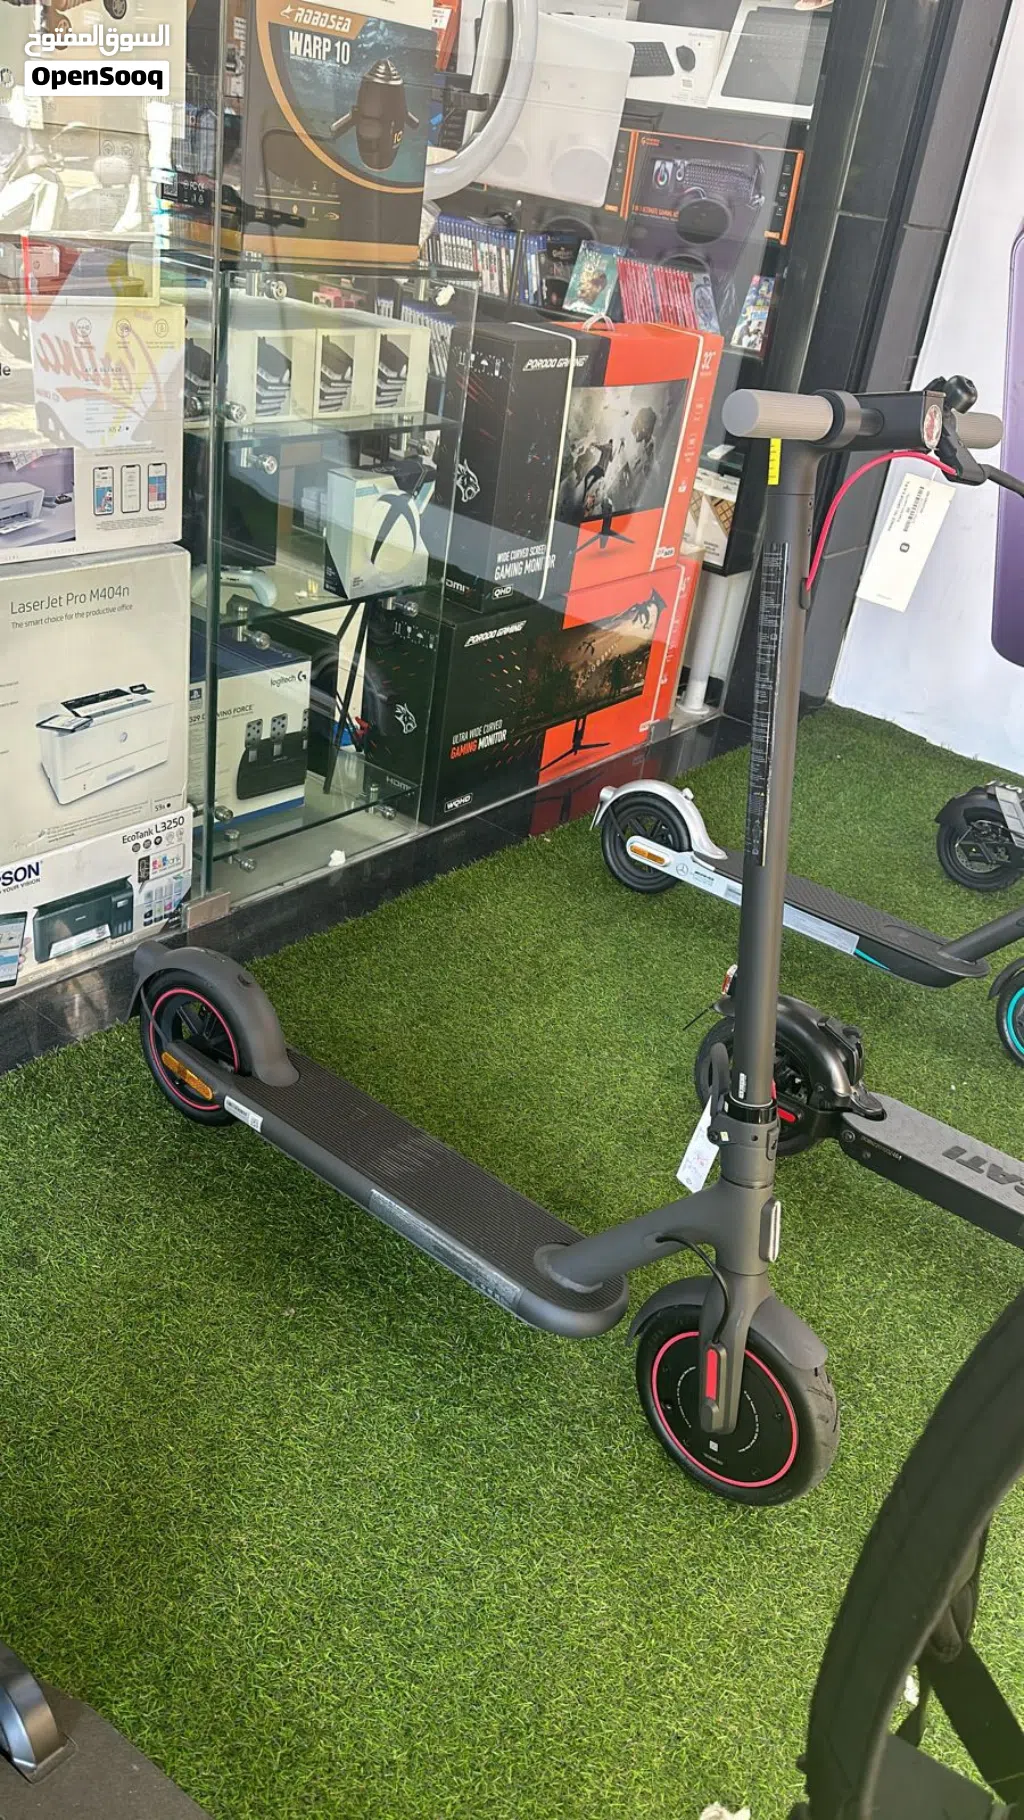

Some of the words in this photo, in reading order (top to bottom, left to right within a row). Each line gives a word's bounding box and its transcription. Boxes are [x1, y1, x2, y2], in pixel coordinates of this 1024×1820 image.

[294, 7, 352, 33] ROBOSEA
[289, 30, 332, 61] WARP
[335, 41, 351, 65] 10
[556, 355, 589, 368] GANG
[494, 561, 523, 581] GAMING
[10, 596, 63, 615] LaserJet
[66, 592, 87, 606] Pro
[89, 585, 130, 602] M404n
[494, 586, 512, 598] QHD
[12, 621, 24, 629] The
[24, 618, 43, 628] smart
[44, 615, 64, 625] choice
[64, 612, 74, 621] for
[74, 611, 85, 619] the
[85, 606, 117, 618] productive
[117, 603, 133, 612] office
[271, 675, 297, 687] logitech
[233, 704, 253, 714] FORCE
[450, 739, 478, 759] GAMING
[478, 729, 507, 750] MONITOR
[452, 732, 468, 745] ULTRA
[469, 727, 483, 739] WIDE
[483, 719, 503, 733] CURVED
[446, 795, 471, 809] WQHD
[122, 828, 153, 844] EcoTank
[154, 815, 185, 834] L3250
[0, 861, 40, 887] SON
[3, 883, 20, 894] YOUR
[20, 877, 41, 888] VISION
